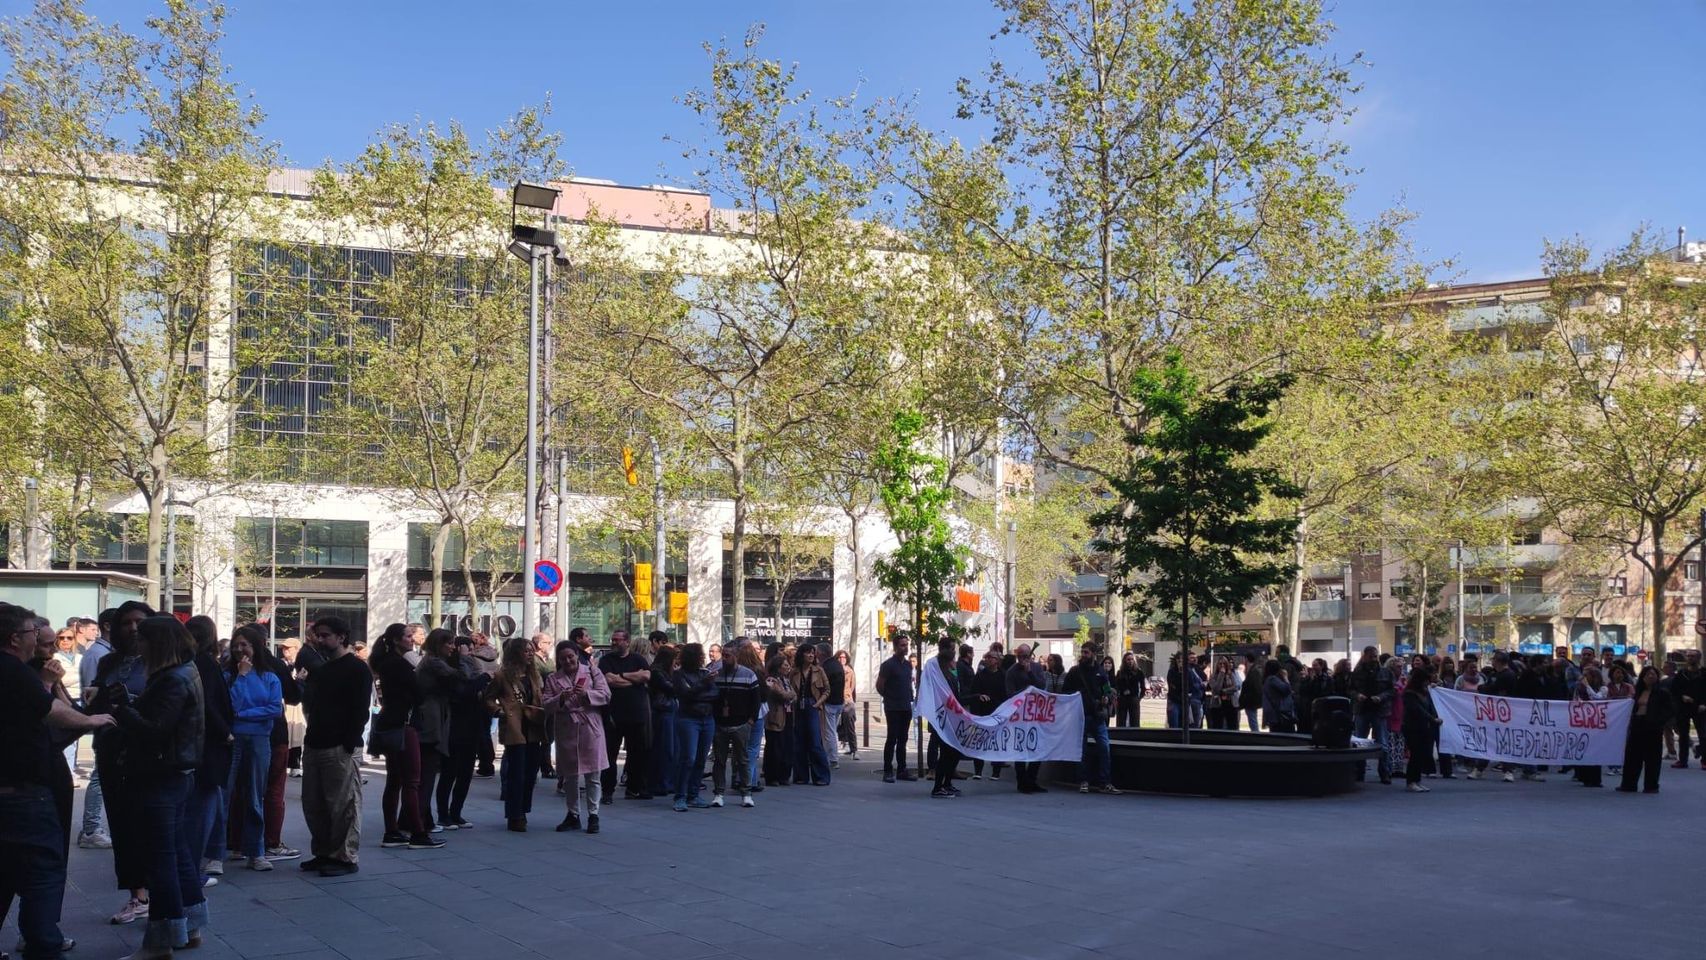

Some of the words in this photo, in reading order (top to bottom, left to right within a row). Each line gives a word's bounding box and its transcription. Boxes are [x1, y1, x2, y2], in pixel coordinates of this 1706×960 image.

[1474, 695, 1512, 723] NO
[1529, 700, 1556, 727] AL
[1568, 701, 1608, 729] ERE
[1457, 723, 1487, 752] EN
